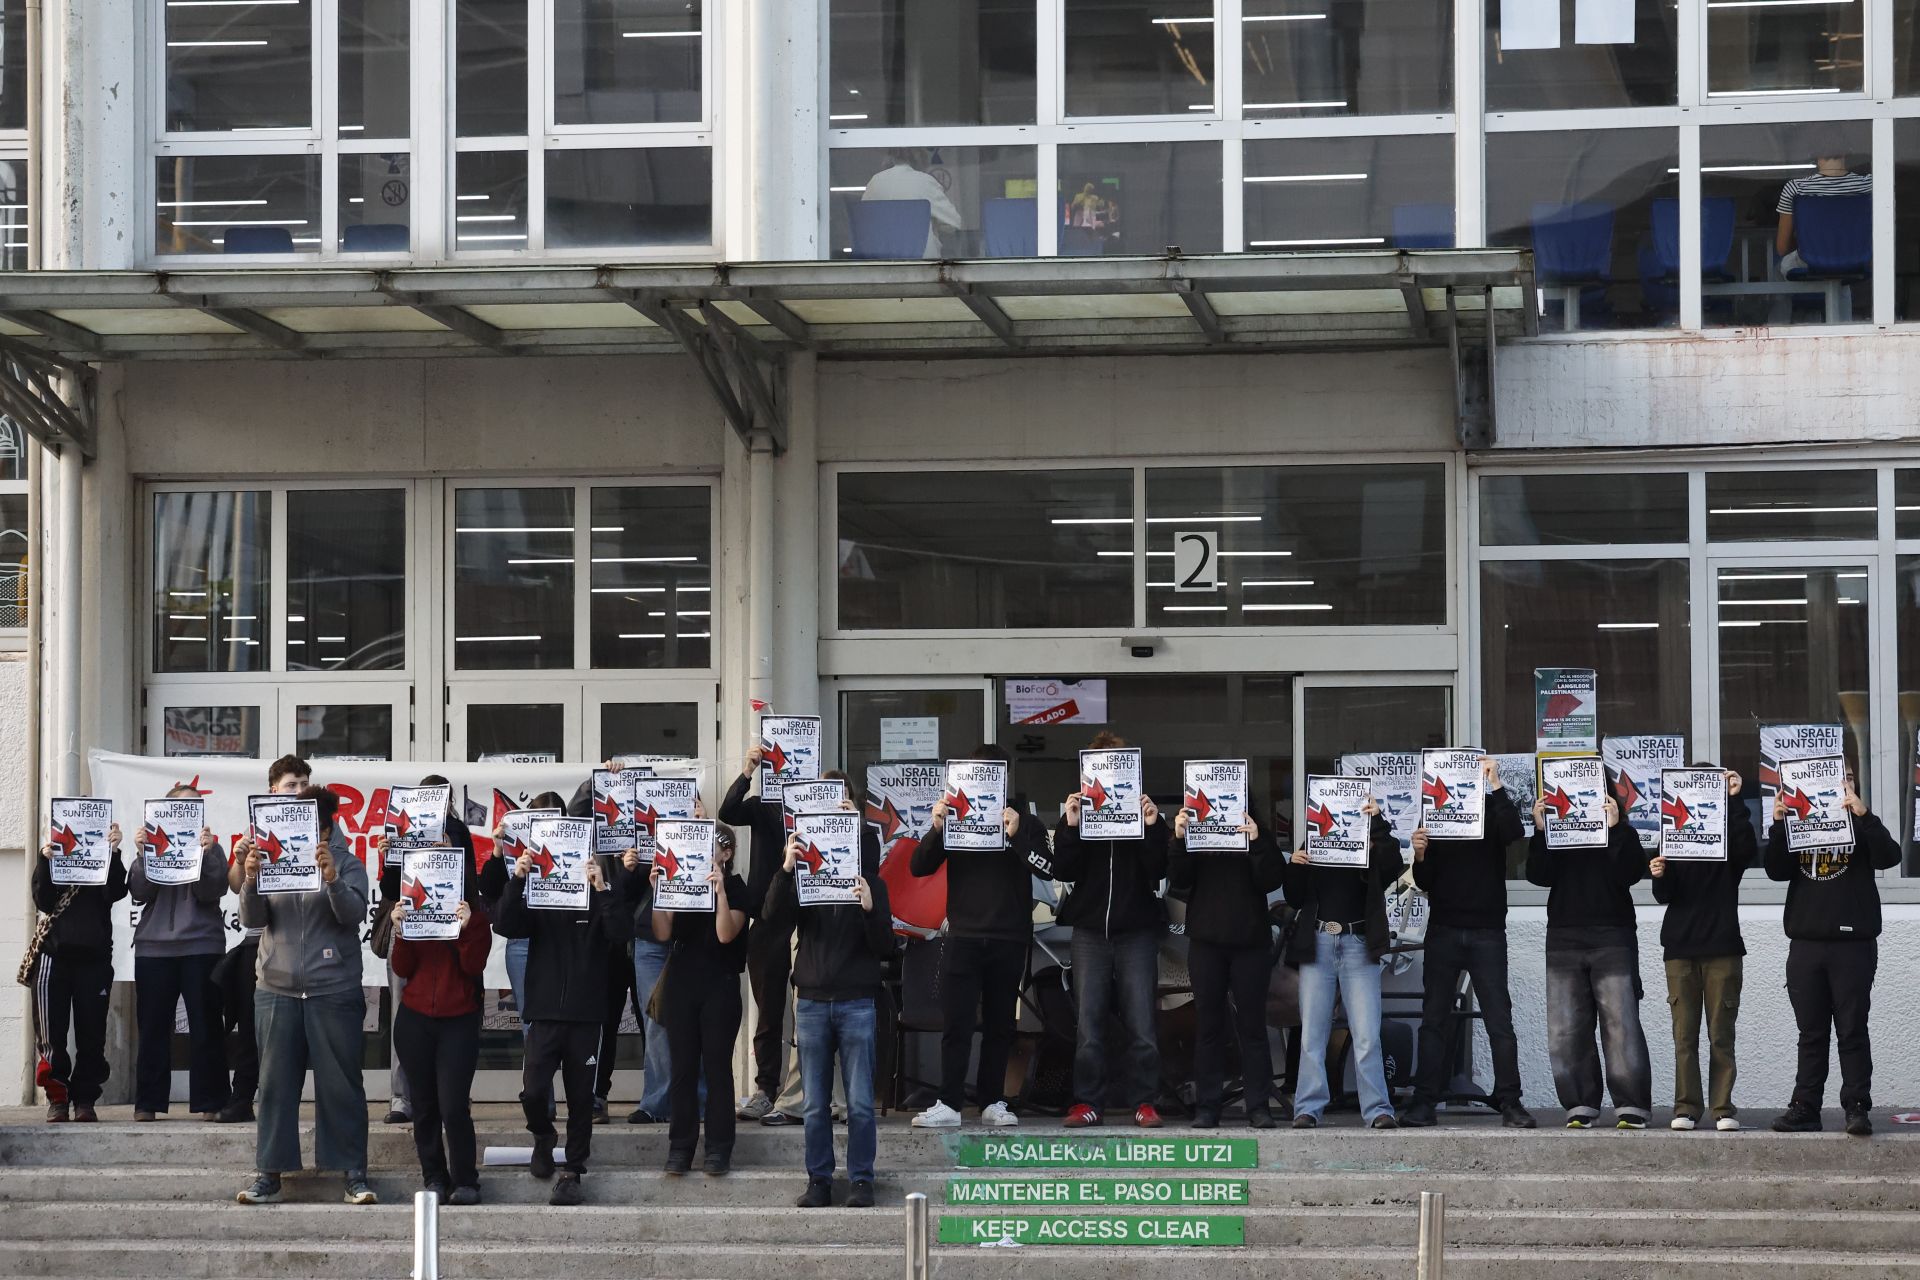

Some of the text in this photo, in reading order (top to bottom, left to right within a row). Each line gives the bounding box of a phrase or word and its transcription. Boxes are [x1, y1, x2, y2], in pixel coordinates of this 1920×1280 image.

[1181, 534, 1212, 588] 2
[1797, 728, 1837, 738] ISRAEL
[1639, 739, 1678, 749] ISRAEL
[1774, 739, 1837, 748] SUNTSITU!
[1616, 749, 1678, 759] SUNTSITU!
[1378, 756, 1416, 766] ISRAEL
[1808, 761, 1838, 770] ISRAEL
[1092, 762, 1134, 770] SUNTSITU!
[902, 768, 940, 777] ISRAEL
[1355, 767, 1416, 776] SUNTSITU!
[1554, 770, 1599, 778] SUNTSITU!
[1792, 770, 1839, 780] SUNTSITU!
[880, 778, 940, 786] SUNTSITU!
[402, 794, 442, 803] SUNTSITU!
[794, 793, 838, 802] SUNTSITU!
[266, 814, 312, 822] SUNTSITU!
[558, 823, 586, 831] ISRAEL
[1792, 822, 1846, 831] MOBILIZAZIOA
[1116, 1144, 1175, 1162] LIBRE
[1185, 1145, 1232, 1162] UTZI
[953, 1183, 1241, 1201] MANTENER EL PASO LIBRE
[972, 1220, 1209, 1239] KEEP ACCESS CLEAR
